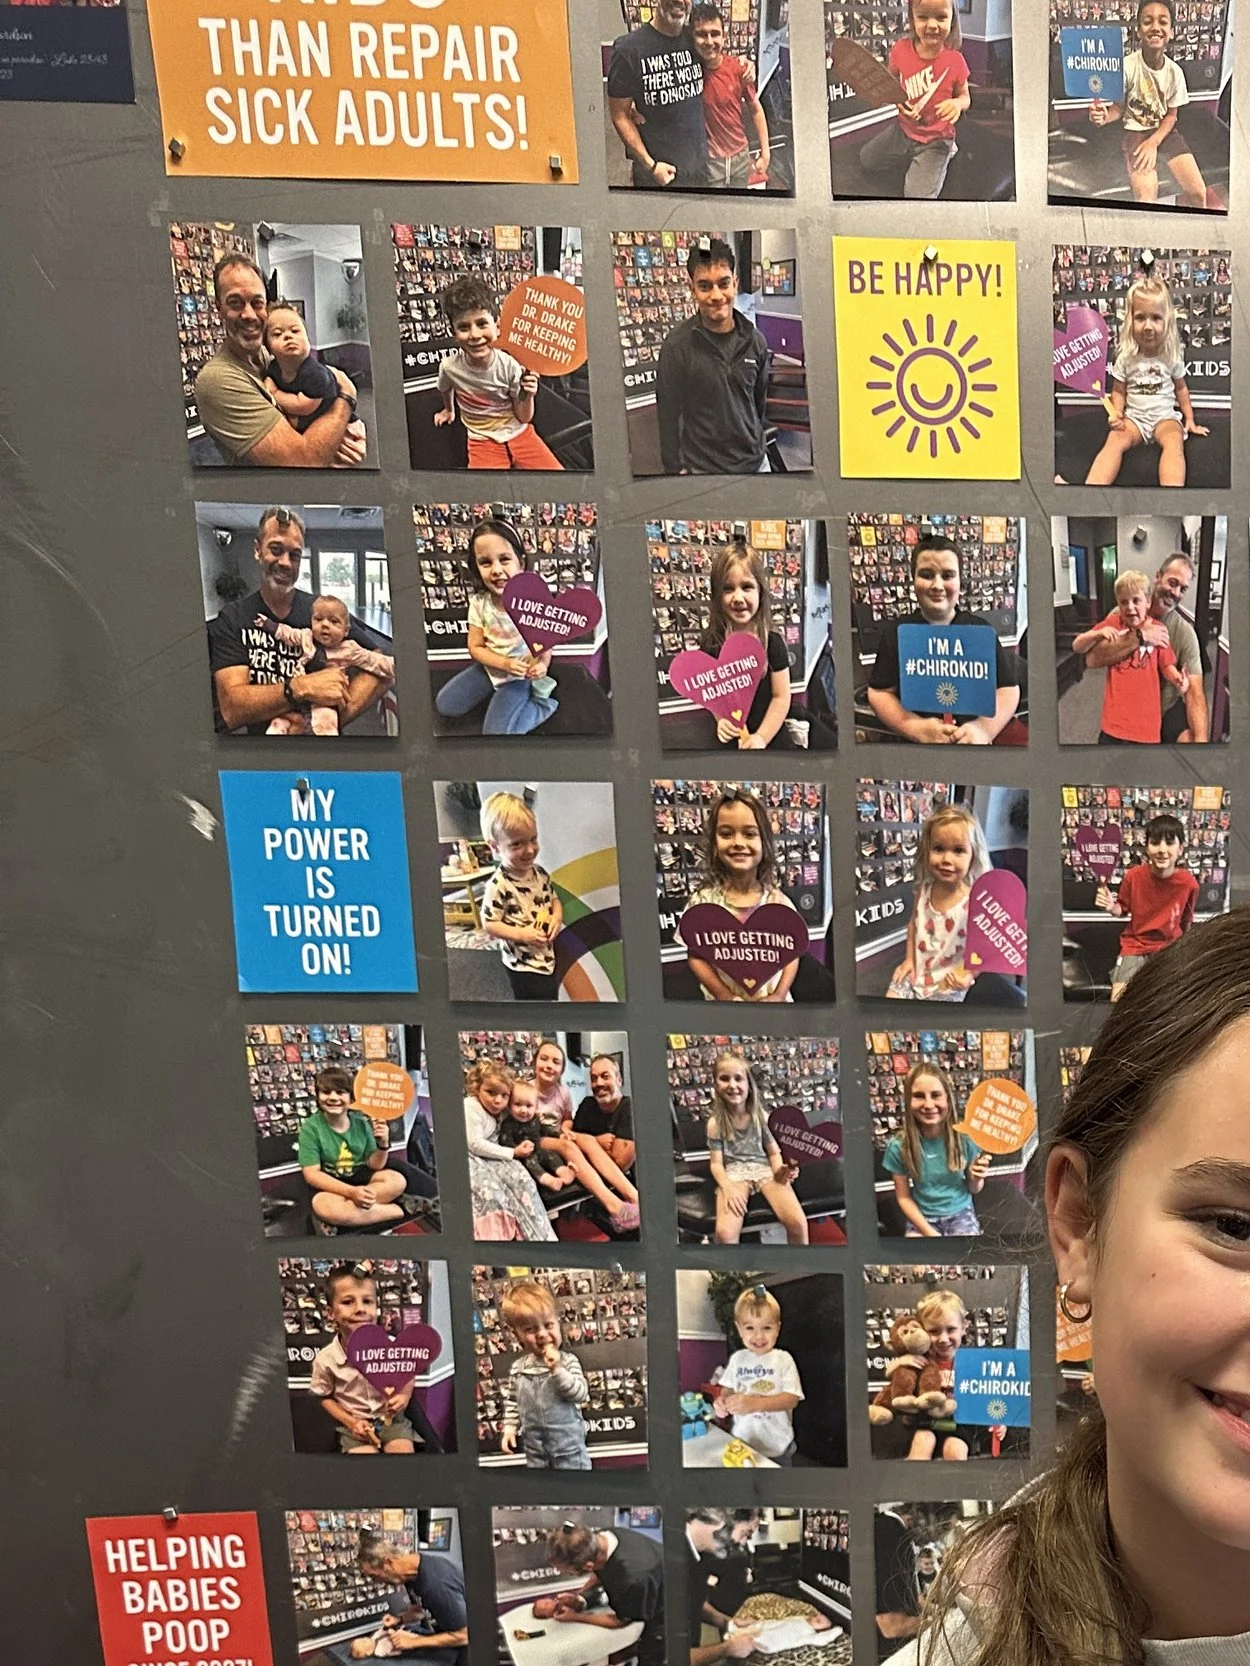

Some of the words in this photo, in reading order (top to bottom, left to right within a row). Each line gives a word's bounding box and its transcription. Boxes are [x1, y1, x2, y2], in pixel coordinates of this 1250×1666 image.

[198, 18, 331, 79] THAN
[352, 23, 521, 83] REPAIR
[641, 59, 646, 73] I
[647, 54, 670, 72] WAS
[671, 50, 692, 68] TOLD
[1081, 38, 1097, 54] I'M
[1098, 39, 1105, 53] A
[643, 70, 675, 90] THERE
[1067, 56, 1120, 72] #CHIROKID!
[904, 65, 935, 101] NIKE
[207, 87, 321, 146] SICK
[335, 90, 529, 151] ADULTS!
[848, 260, 884, 294] BE
[895, 262, 1002, 297] HAPPY!
[522, 303, 538, 321] DR.
[541, 310, 576, 334] DRAKE
[525, 287, 558, 310] THANK
[560, 299, 584, 319] YOU
[508, 330, 523, 346] ME
[524, 338, 572, 365] HEALTHY!
[512, 316, 531, 335] FOR
[533, 324, 576, 351] KEEPING
[1053, 344, 1071, 365] OVE
[1069, 328, 1103, 350] GETTING
[1060, 345, 1102, 379] ADJUSTED!
[511, 597, 516, 609] I
[518, 598, 544, 615] LOVE
[545, 605, 587, 628] GETTING
[519, 614, 570, 636] ADJUSTED!
[928, 637, 949, 656] I'M
[954, 639, 964, 656] A
[684, 678, 691, 691] I
[690, 669, 718, 689] LOVE
[719, 655, 758, 677] GETTING
[905, 659, 988, 680] #CHIROKID!
[701, 674, 753, 702] ADJUSTED!
[290, 788, 335, 822] MY
[263, 828, 370, 860] POWER
[305, 867, 336, 899] IS
[263, 905, 381, 937] TURNED
[976, 890, 987, 901] I
[982, 895, 1011, 926] LOVE
[696, 933, 702, 946] I
[704, 932, 737, 945] LOVE
[739, 932, 794, 950] GETTING
[714, 948, 780, 963] ADJUSTED!
[973, 913, 1025, 968] ADJUSTED!
[301, 943, 351, 975] ON!
[774, 1123, 779, 1131] I
[779, 1125, 801, 1138] LOVE
[801, 1132, 839, 1154] GETTING
[780, 1136, 824, 1159] ADJUSTED!
[356, 1351, 360, 1362] I
[362, 1349, 386, 1361] LOVE
[388, 1347, 430, 1360] GETTING
[366, 1361, 416, 1374] ADJUSTED!
[982, 1360, 1002, 1377] I'M
[1006, 1362, 1016, 1377] A
[105, 1535, 246, 1573] HELPING
[122, 1576, 241, 1614] BABIES
[142, 1618, 230, 1655] POOP
